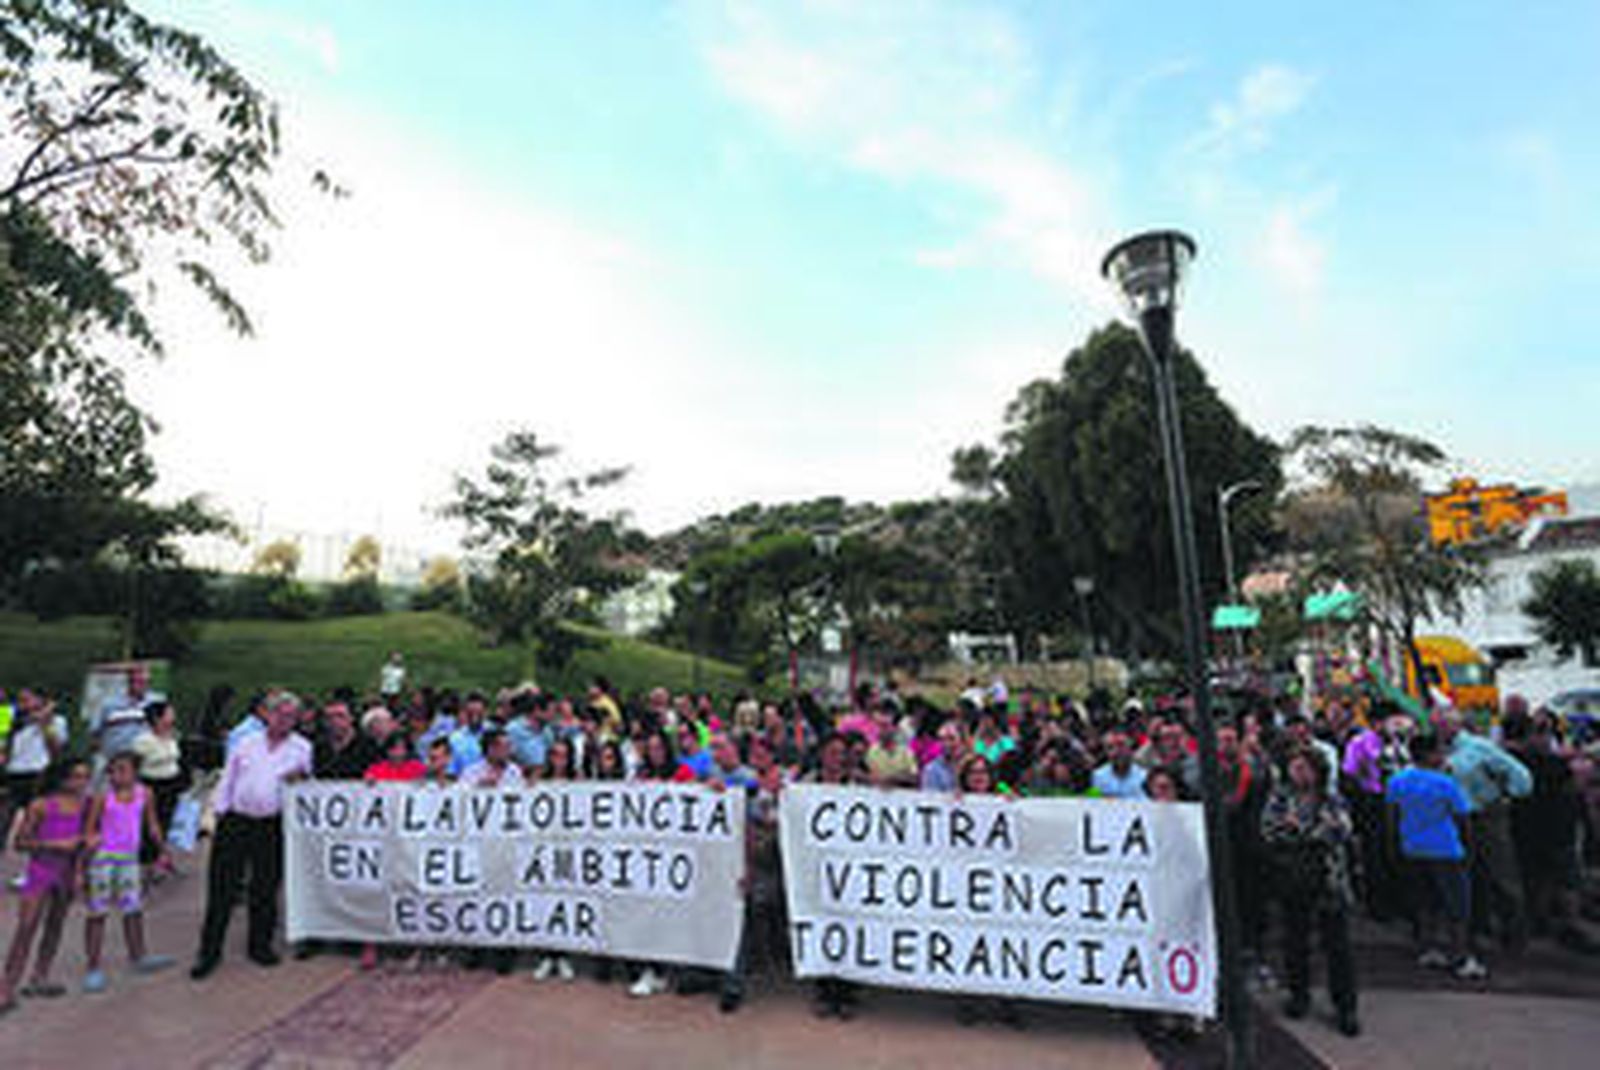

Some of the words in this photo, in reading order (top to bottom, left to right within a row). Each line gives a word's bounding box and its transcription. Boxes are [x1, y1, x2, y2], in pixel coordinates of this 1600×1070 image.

[300, 797, 349, 829] NO
[365, 799, 386, 829] A
[404, 798, 455, 831] LA
[471, 793, 730, 834] VIOLENCIA
[811, 802, 1013, 849] CONTRA
[1084, 813, 1149, 856] LA
[330, 845, 380, 880] EN
[425, 849, 476, 885] EL
[524, 845, 693, 892] ÁMBITO
[826, 863, 1147, 922] VIOLENCIA
[396, 901, 596, 938] ESCOLAR
[796, 921, 1147, 989] TOLERANCIA
